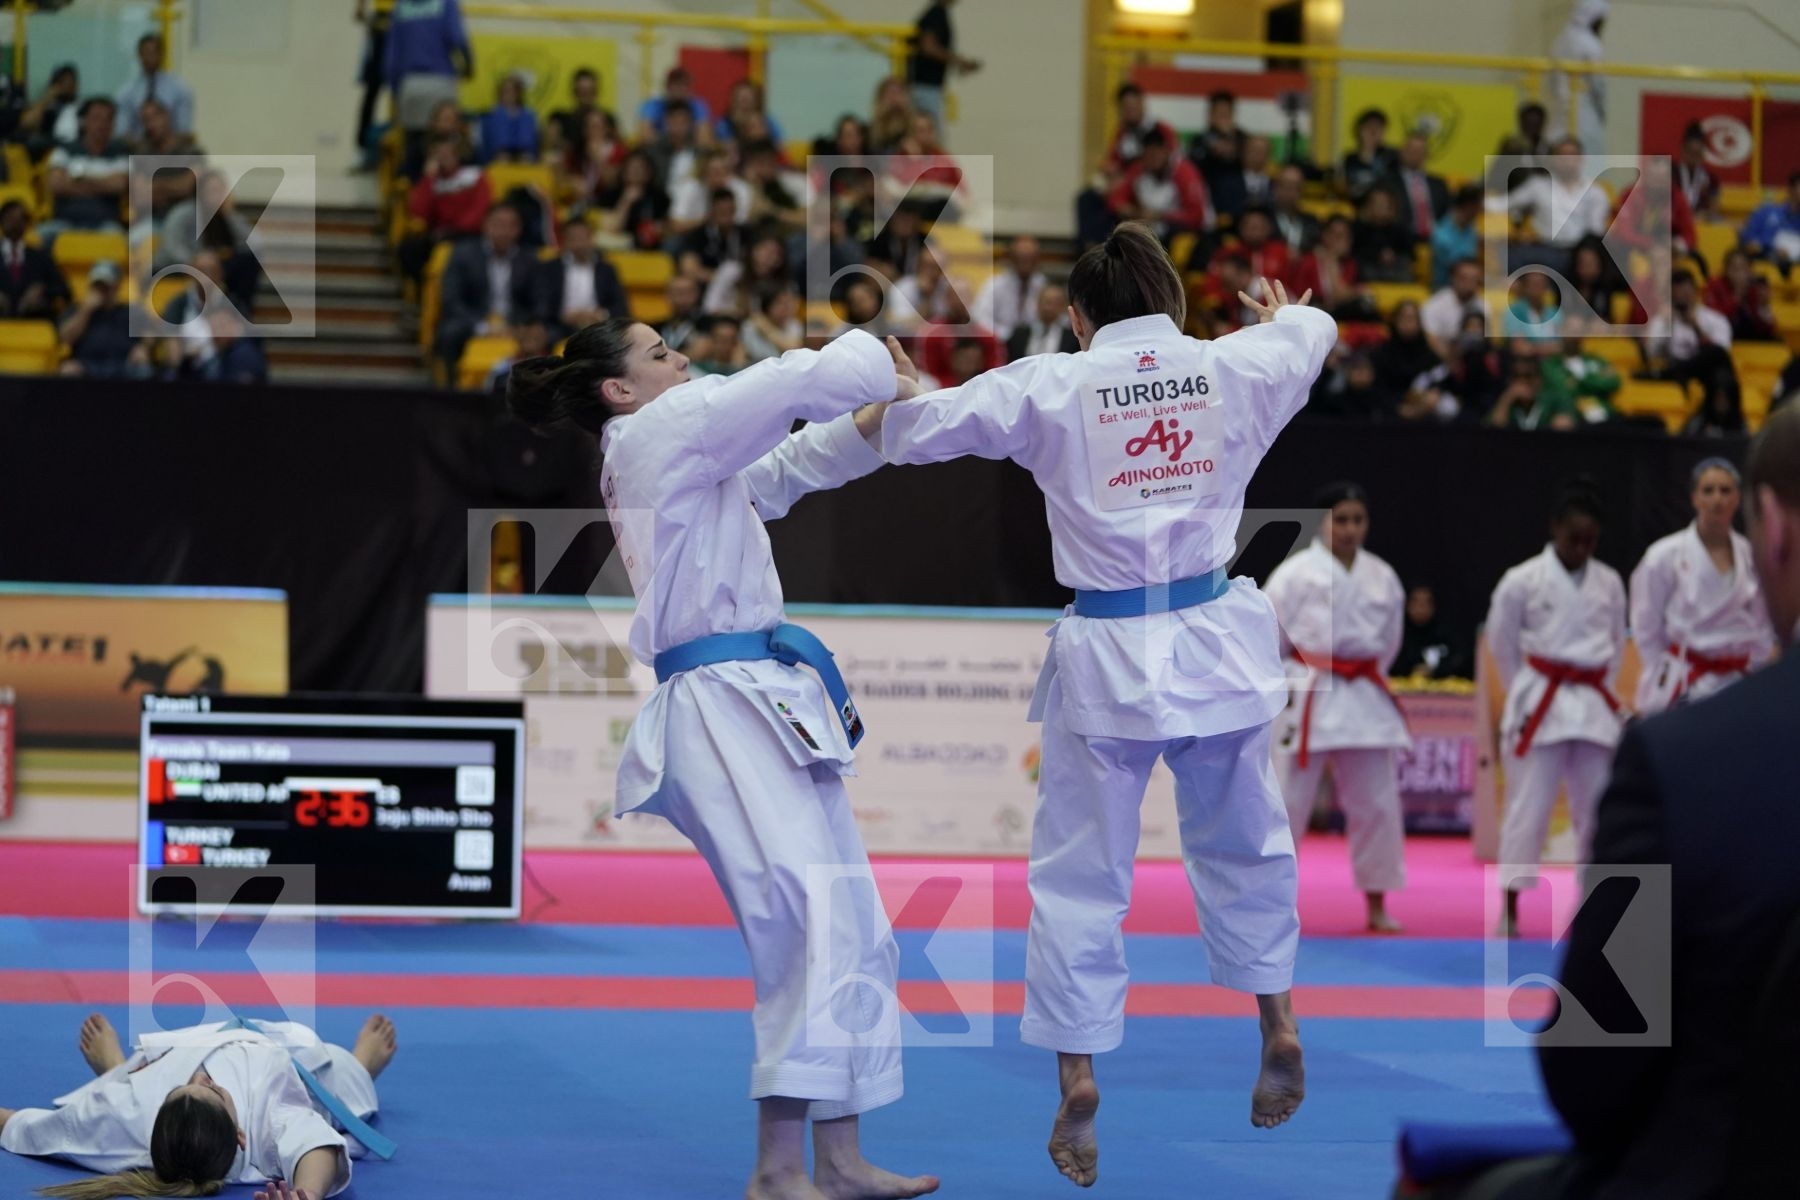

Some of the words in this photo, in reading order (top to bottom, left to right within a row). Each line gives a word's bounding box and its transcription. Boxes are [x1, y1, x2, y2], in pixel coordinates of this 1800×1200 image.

[1096, 375, 1209, 409] TUR0346
[1099, 412, 1118, 424] Eat
[1122, 408, 1150, 420] Well,
[1153, 405, 1178, 417] Live
[1180, 400, 1210, 412] Well.
[207, 740, 251, 761] Team
[253, 742, 291, 762] Kata
[202, 783, 265, 803] UNITED
[166, 826, 234, 846] TURKEY
[202, 848, 271, 868] TURKEY
[448, 873, 492, 892] Anan
